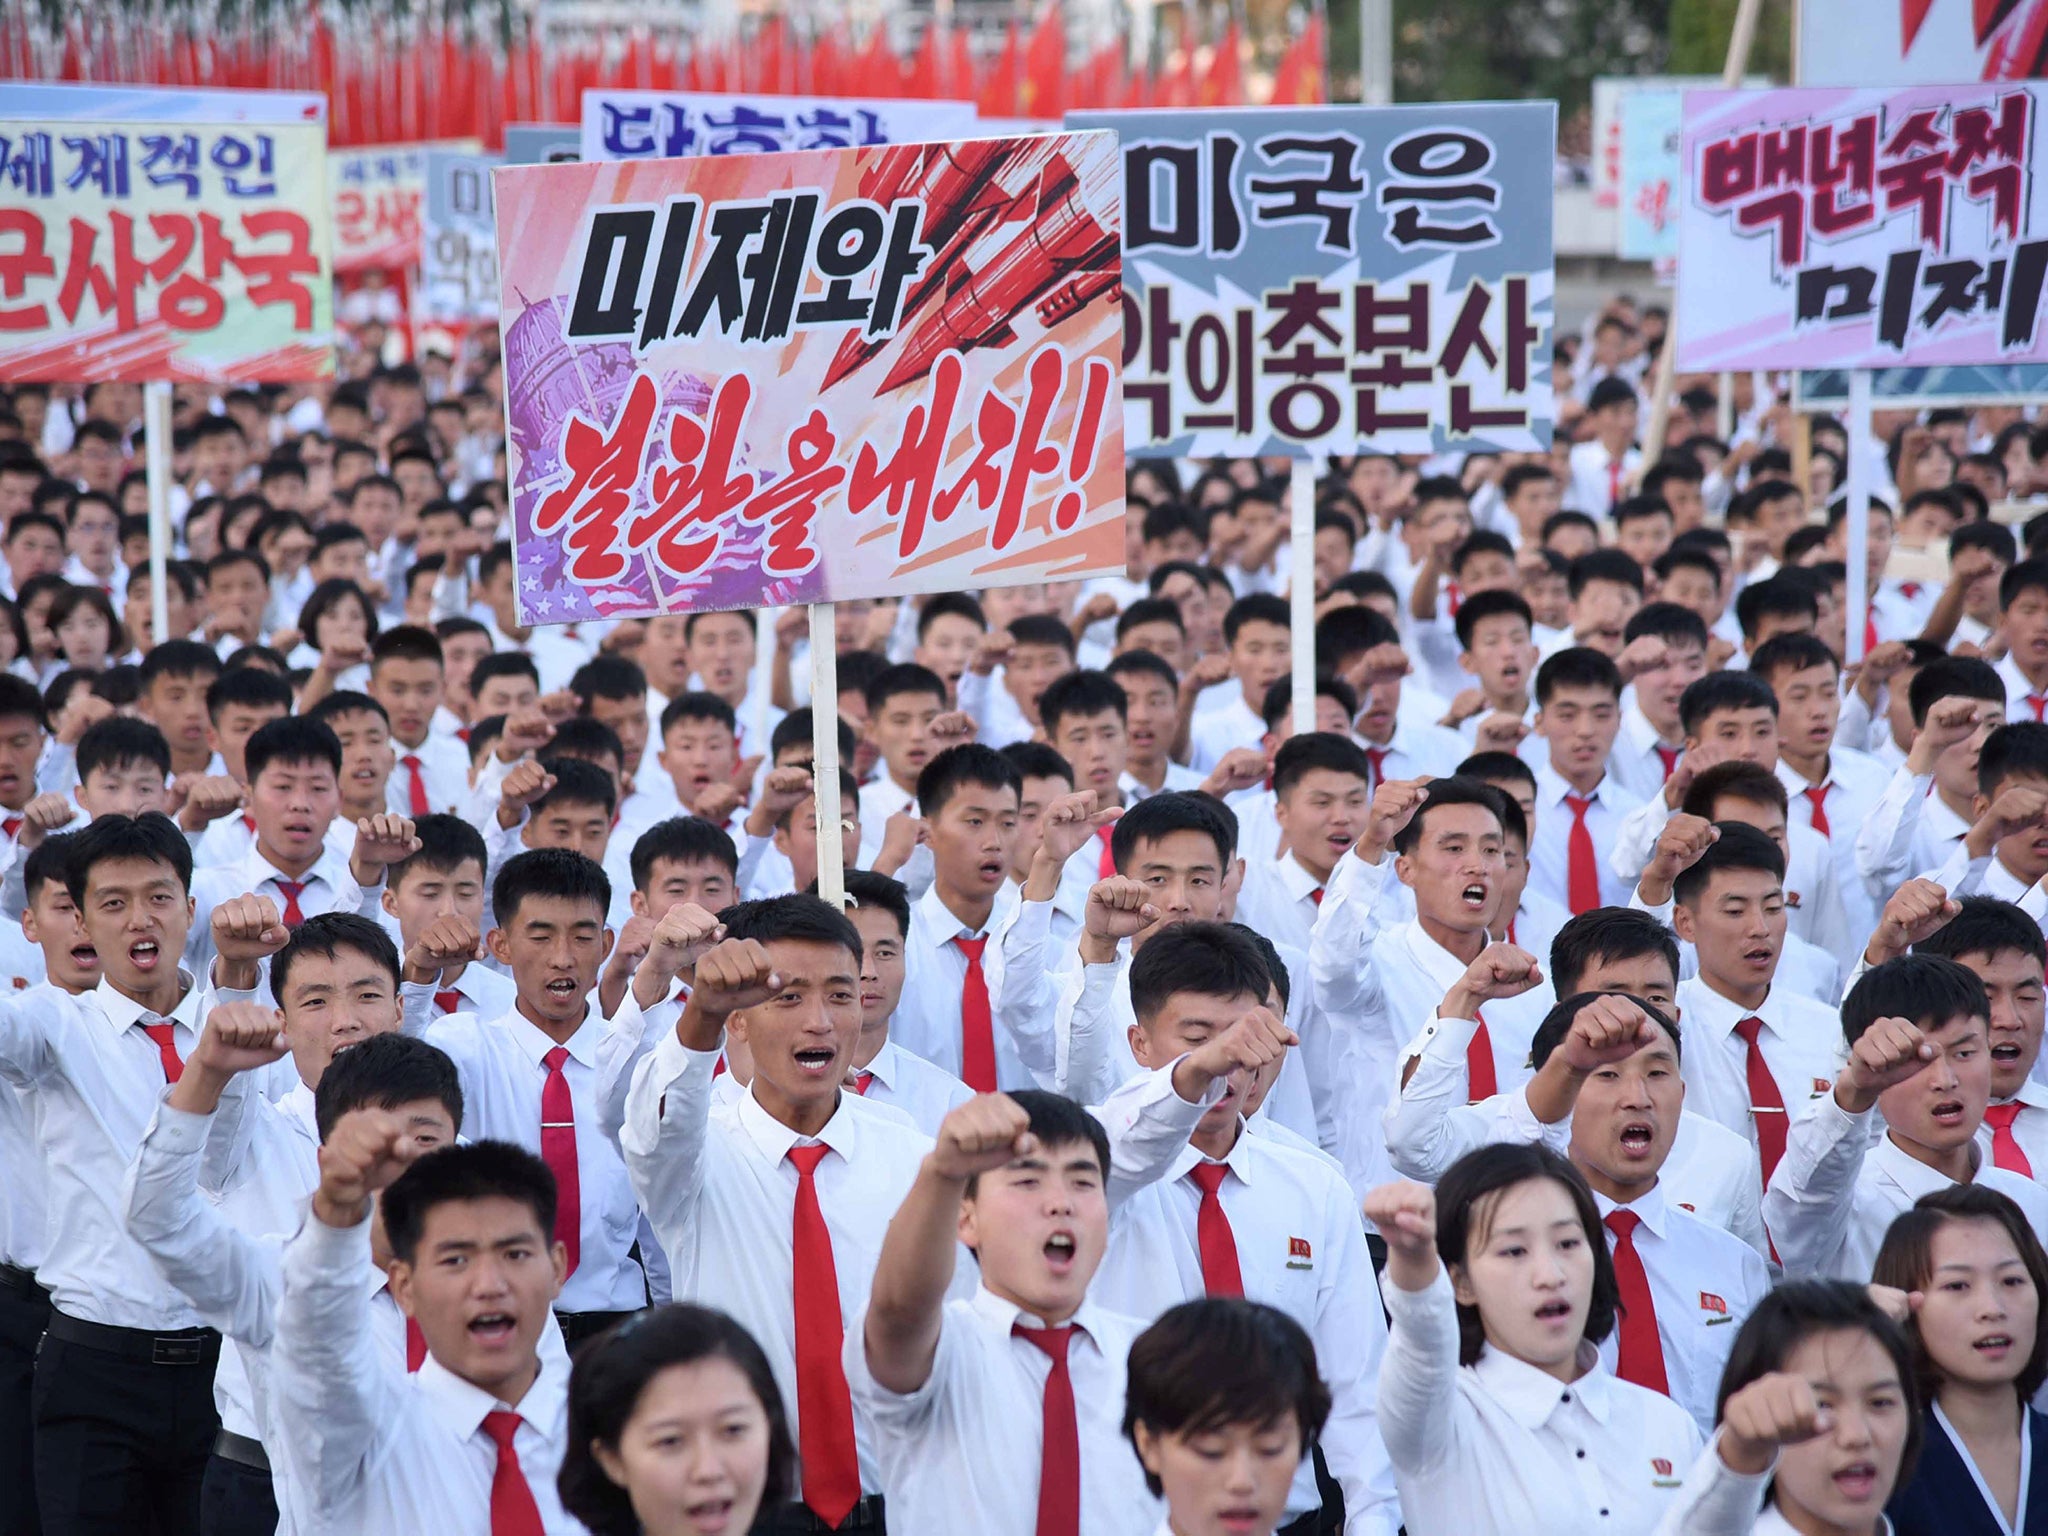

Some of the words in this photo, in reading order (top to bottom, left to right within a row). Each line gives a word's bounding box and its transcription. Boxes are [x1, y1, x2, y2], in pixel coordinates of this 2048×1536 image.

[0, 132, 276, 198] 세계적인
[1126, 132, 1497, 252] 미국은
[1703, 93, 2028, 267] 백년숙적
[0, 209, 320, 332] 군사강국
[568, 195, 928, 351] 미제와
[1796, 241, 2048, 350] 미제
